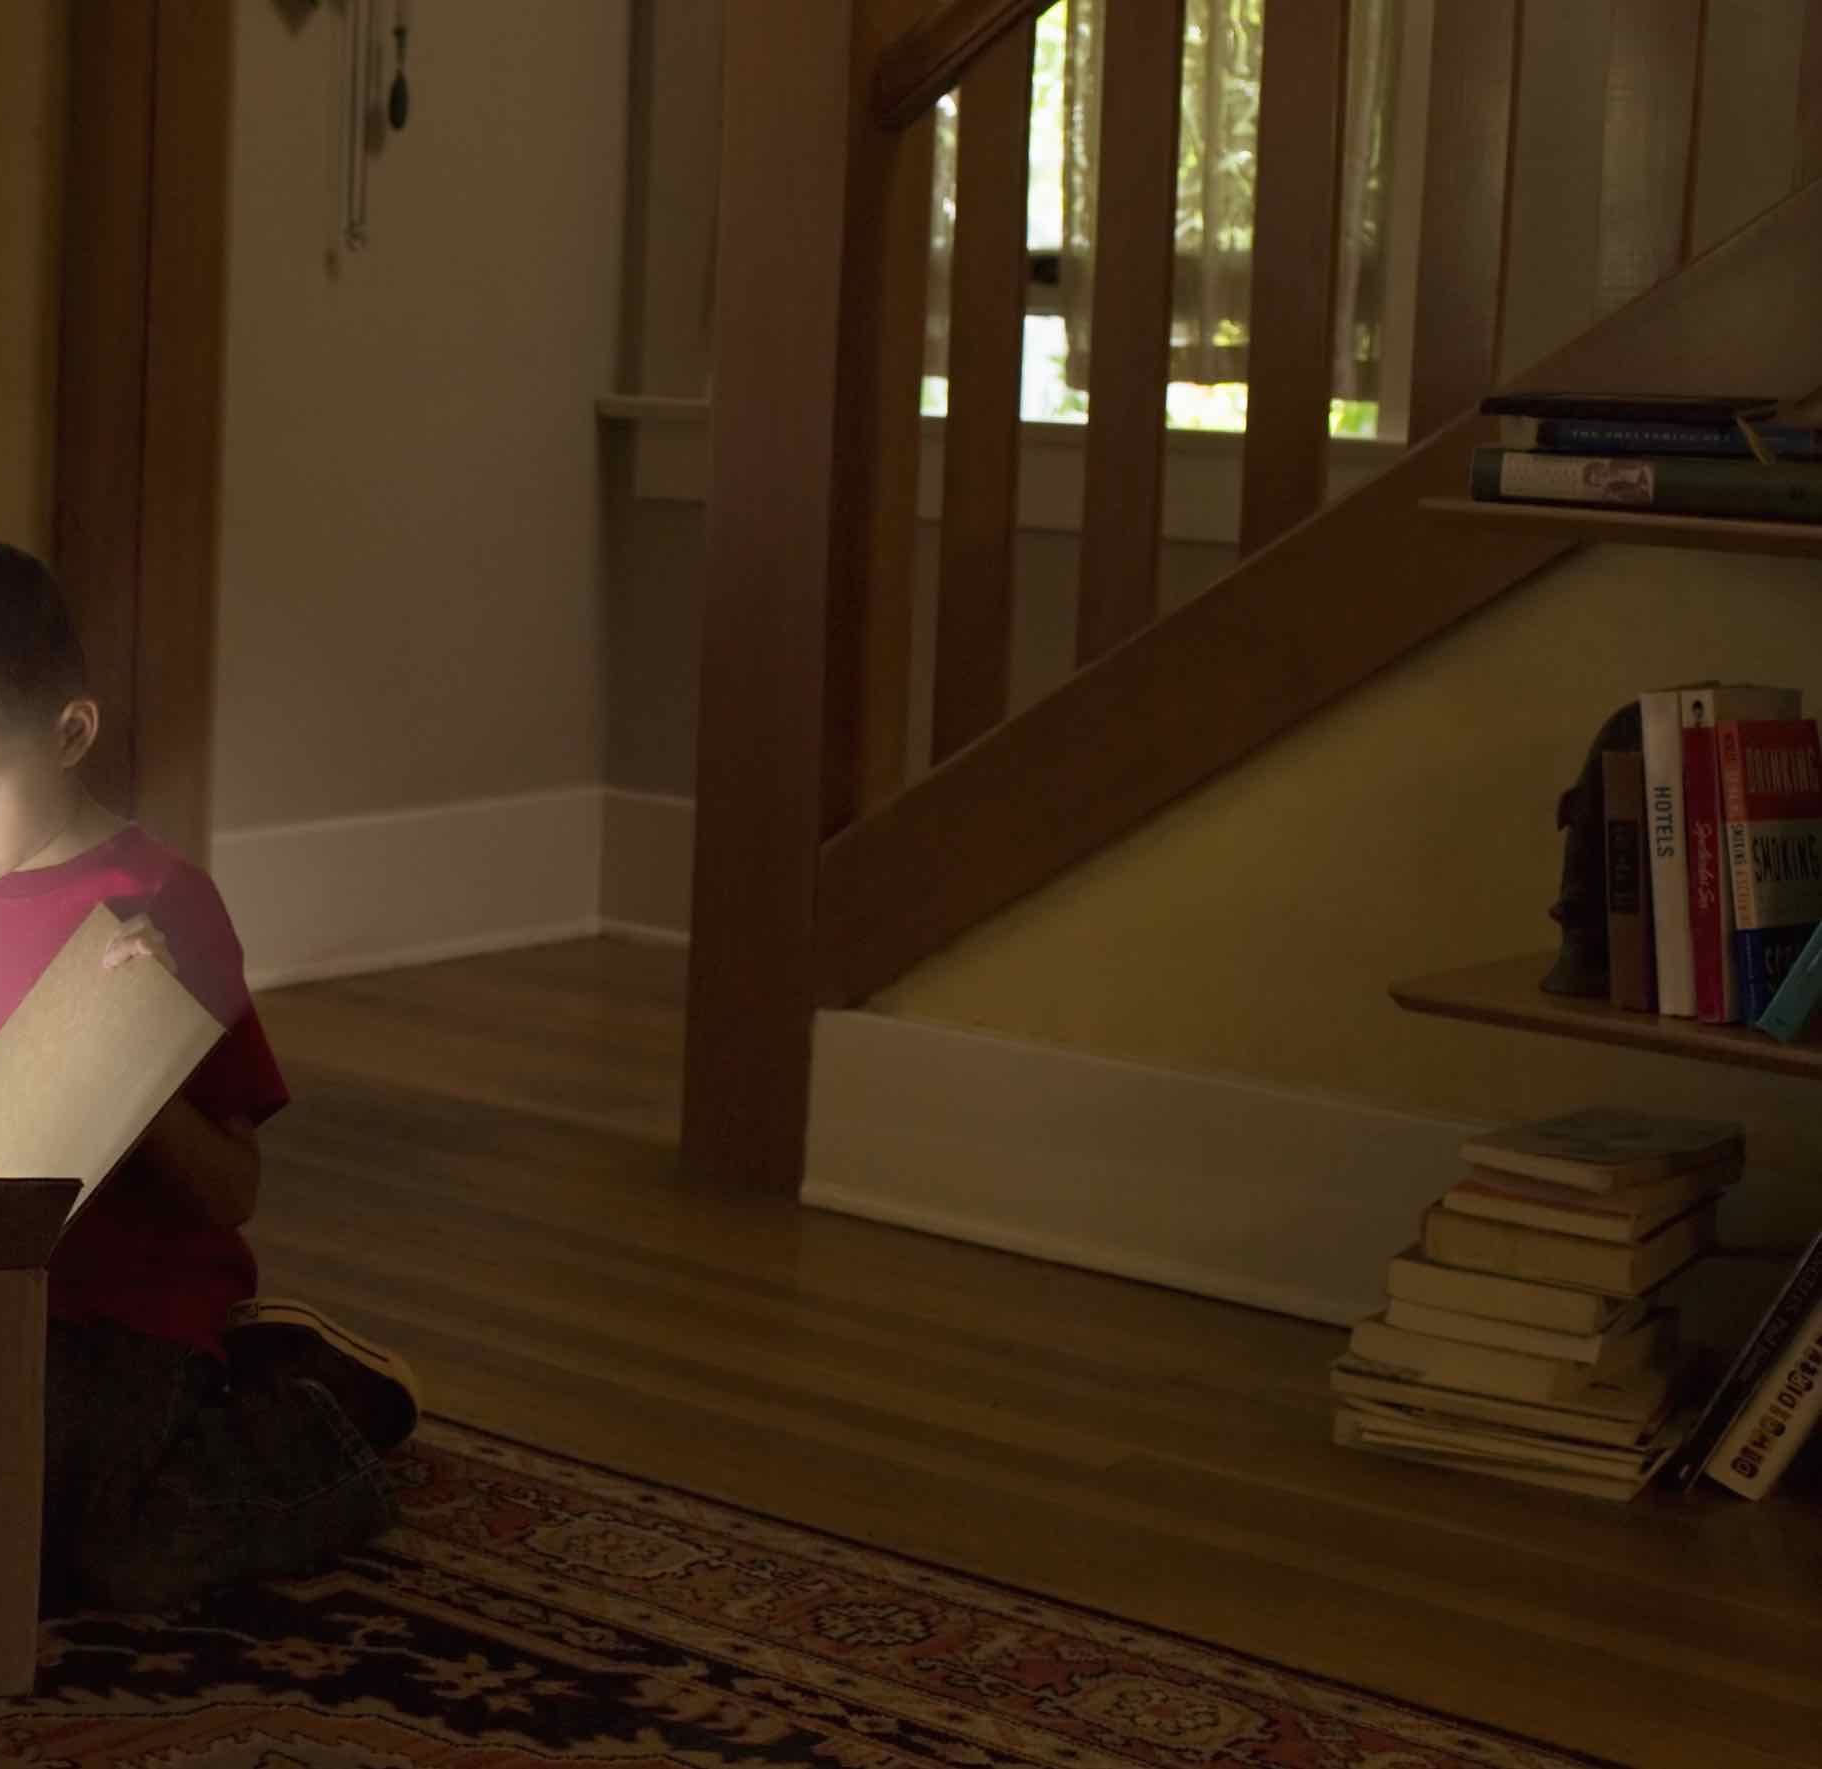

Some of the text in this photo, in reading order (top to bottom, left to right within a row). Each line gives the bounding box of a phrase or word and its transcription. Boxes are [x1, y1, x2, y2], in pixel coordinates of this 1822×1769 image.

[1745, 748, 1819, 793] DRINKING
[1654, 786, 1675, 858] HOTELS
[1751, 834, 1821, 881] SMOKING
